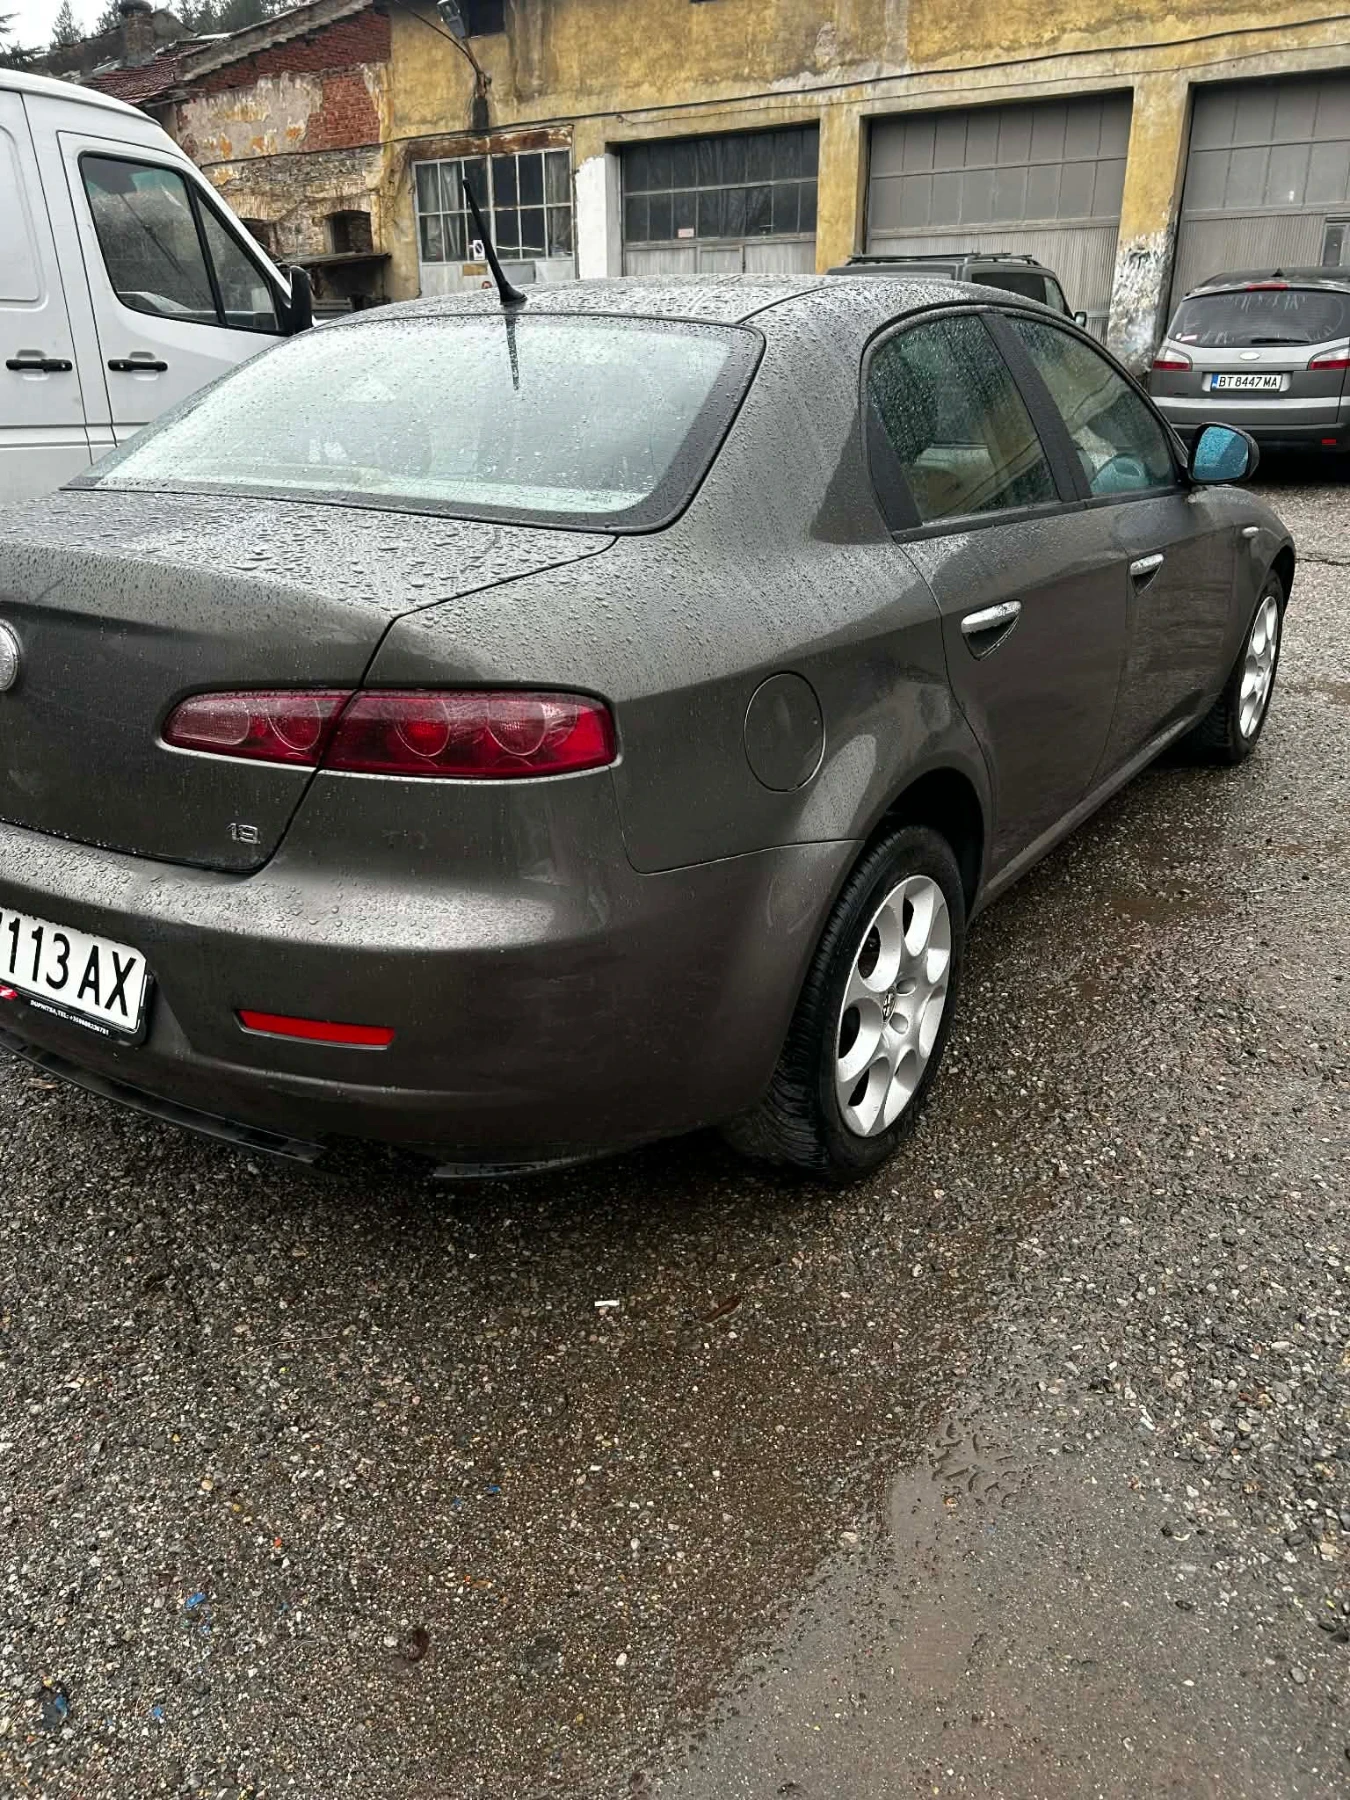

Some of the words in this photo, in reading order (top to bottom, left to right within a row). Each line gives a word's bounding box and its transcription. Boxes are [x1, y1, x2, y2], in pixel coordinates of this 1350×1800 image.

[1218, 376, 1234, 387] BT
[1235, 376, 1262, 387] 8447
[1263, 376, 1277, 387] MA
[0, 912, 70, 990] 113
[77, 945, 137, 1016] AX
